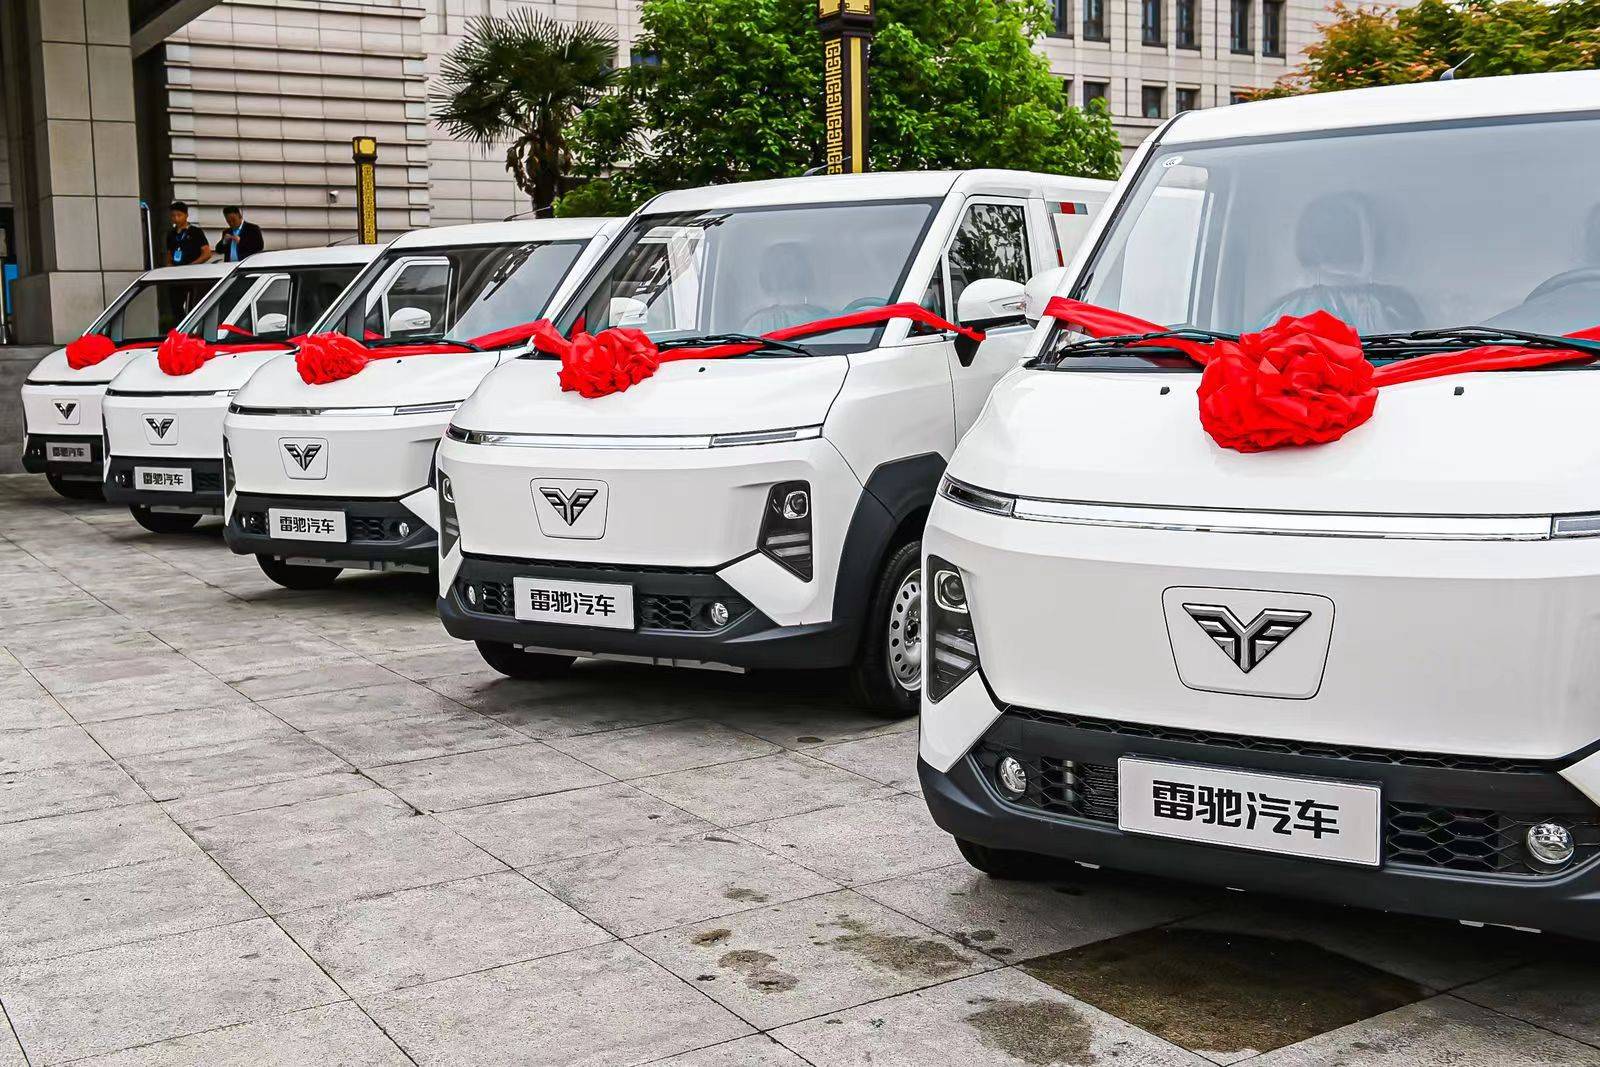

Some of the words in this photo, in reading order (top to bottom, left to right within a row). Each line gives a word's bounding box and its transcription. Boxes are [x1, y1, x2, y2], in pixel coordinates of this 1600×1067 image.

[279, 516, 335, 534] 雷驰汽车
[530, 589, 616, 616] 雷驰汽车
[1153, 780, 1340, 839] 雷驰汽车
